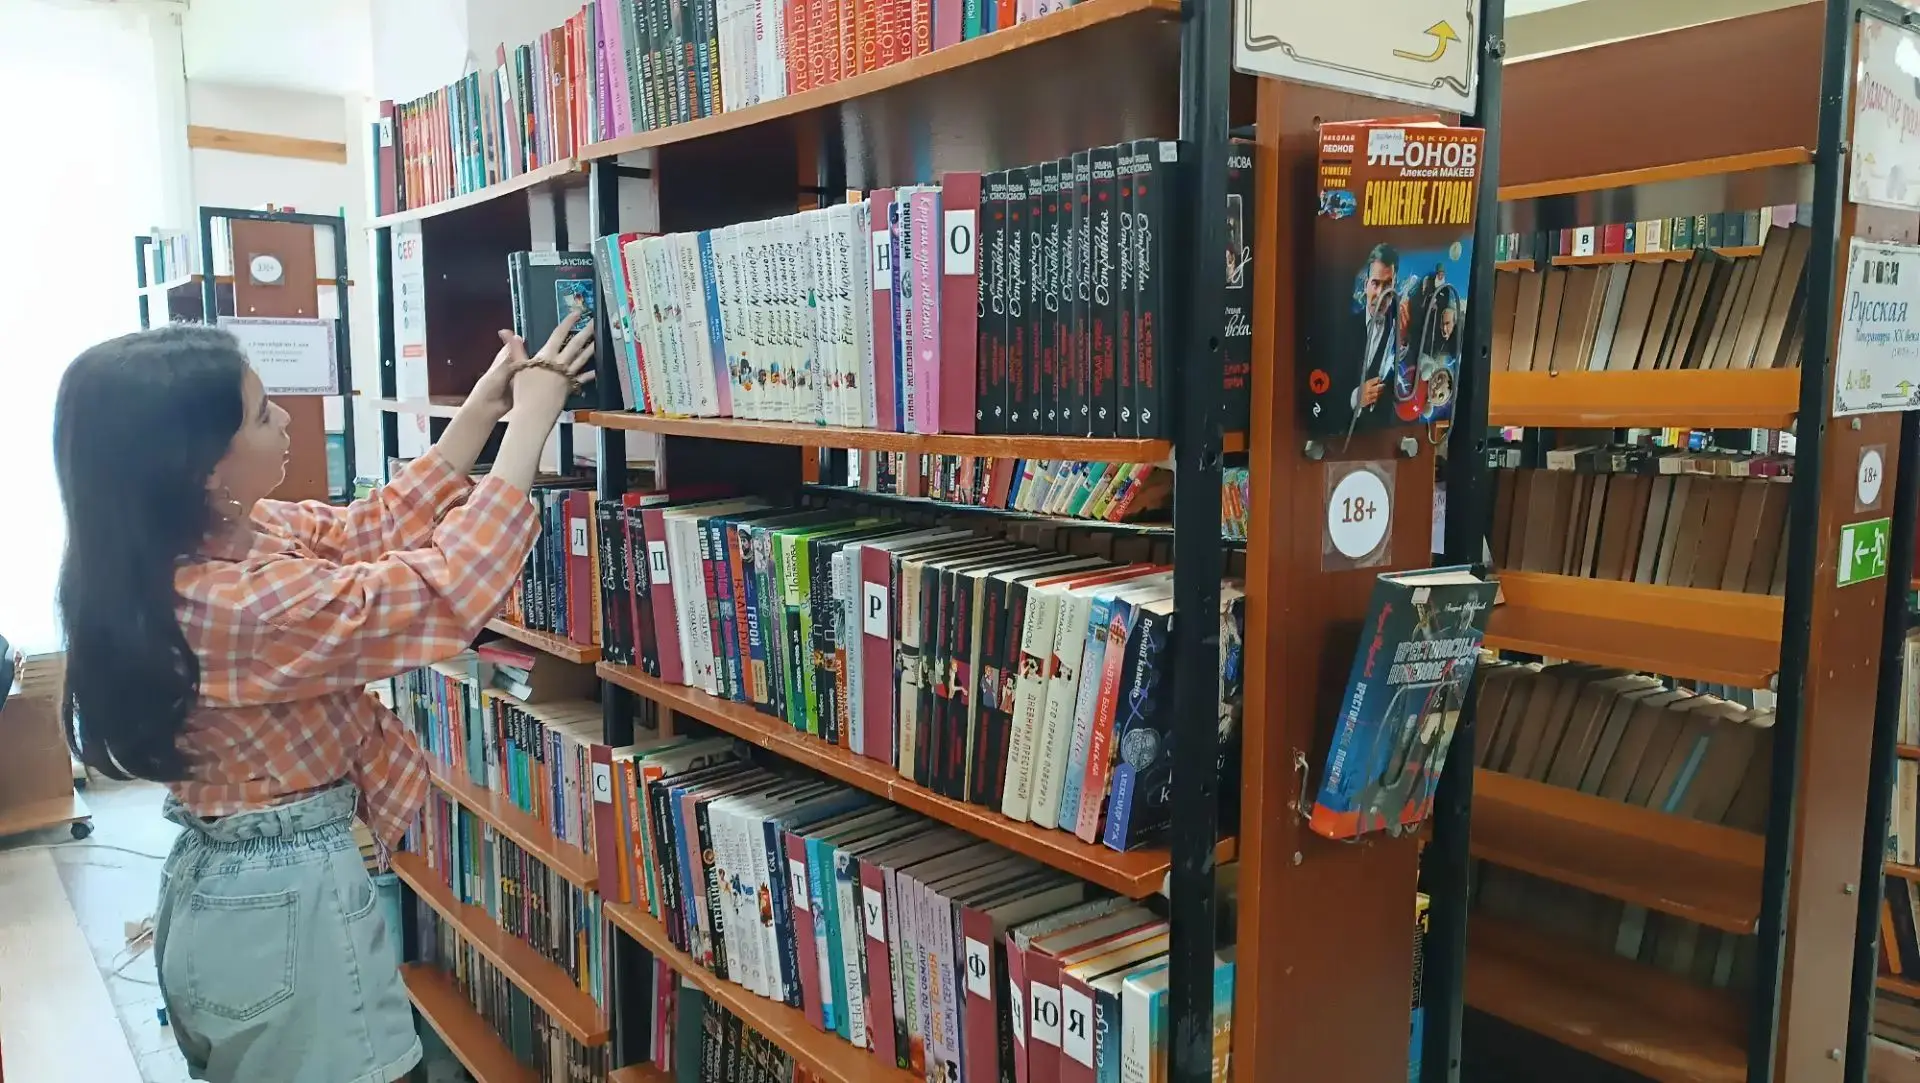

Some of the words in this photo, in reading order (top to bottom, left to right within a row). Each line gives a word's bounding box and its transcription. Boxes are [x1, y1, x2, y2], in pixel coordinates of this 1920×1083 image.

[710, 38, 718, 64] ЮЛИЯ
[794, 5, 807, 91] ЛЕОНТЬЕВ
[812, 0, 824, 87] ЛЕОНТЬЕВ
[844, 0, 856, 78] ЛЕОНТЬЕ
[864, 0, 876, 72] ЛЕОНТЬ
[882, 0, 894, 66] ЛЕОНТЬ
[382, 125, 390, 138] А
[1322, 144, 1354, 153] ЛЕОНОВ
[1400, 168, 1438, 178] Алексей
[1440, 168, 1475, 178] МАКЕЕВ
[1363, 180, 1427, 226] СОМНЕНИЕ
[1428, 180, 1473, 224] ГУРОВА
[877, 244, 890, 272] Н
[950, 225, 970, 254] О
[1096, 209, 1114, 306] Островская
[573, 258, 594, 266] УСТИНО
[836, 231, 852, 302] Михайлова
[992, 228, 1006, 315] Островская
[1009, 230, 1026, 318] Островская
[1848, 291, 1908, 327] Русская
[1863, 466, 1878, 483] 18+
[1342, 496, 1377, 523] 18+
[574, 528, 585, 546] Л
[652, 550, 664, 572] П
[868, 594, 882, 620] Р
[1025, 596, 1037, 650] РОМАНОВА
[747, 606, 760, 647] ГЕРОЙ
[1054, 600, 1066, 652] РОМАНОВА
[1139, 618, 1153, 658] Волчий
[1104, 658, 1117, 695] ЗАВТРА
[1132, 659, 1146, 698] камень
[1025, 692, 1036, 742] ДНЕВНИКИ
[1099, 698, 1110, 728] БЫЛИ
[1045, 720, 1056, 758] ПРИЧИН
[596, 774, 608, 792] С
[1019, 743, 1032, 800] ПРЕСТУПНОЙ
[1038, 760, 1051, 808] ПОВЕРИТЬ
[794, 873, 804, 896] Т
[867, 902, 878, 925] У
[904, 940, 916, 974] ДАР
[918, 943, 928, 988] ОБМАНУ
[968, 951, 986, 980] Ф
[847, 964, 864, 1040] ТОКАРЕВА
[907, 977, 918, 1032] БОЖИЙ
[1034, 996, 1059, 1028] Ю
[1068, 1008, 1086, 1040] Я
